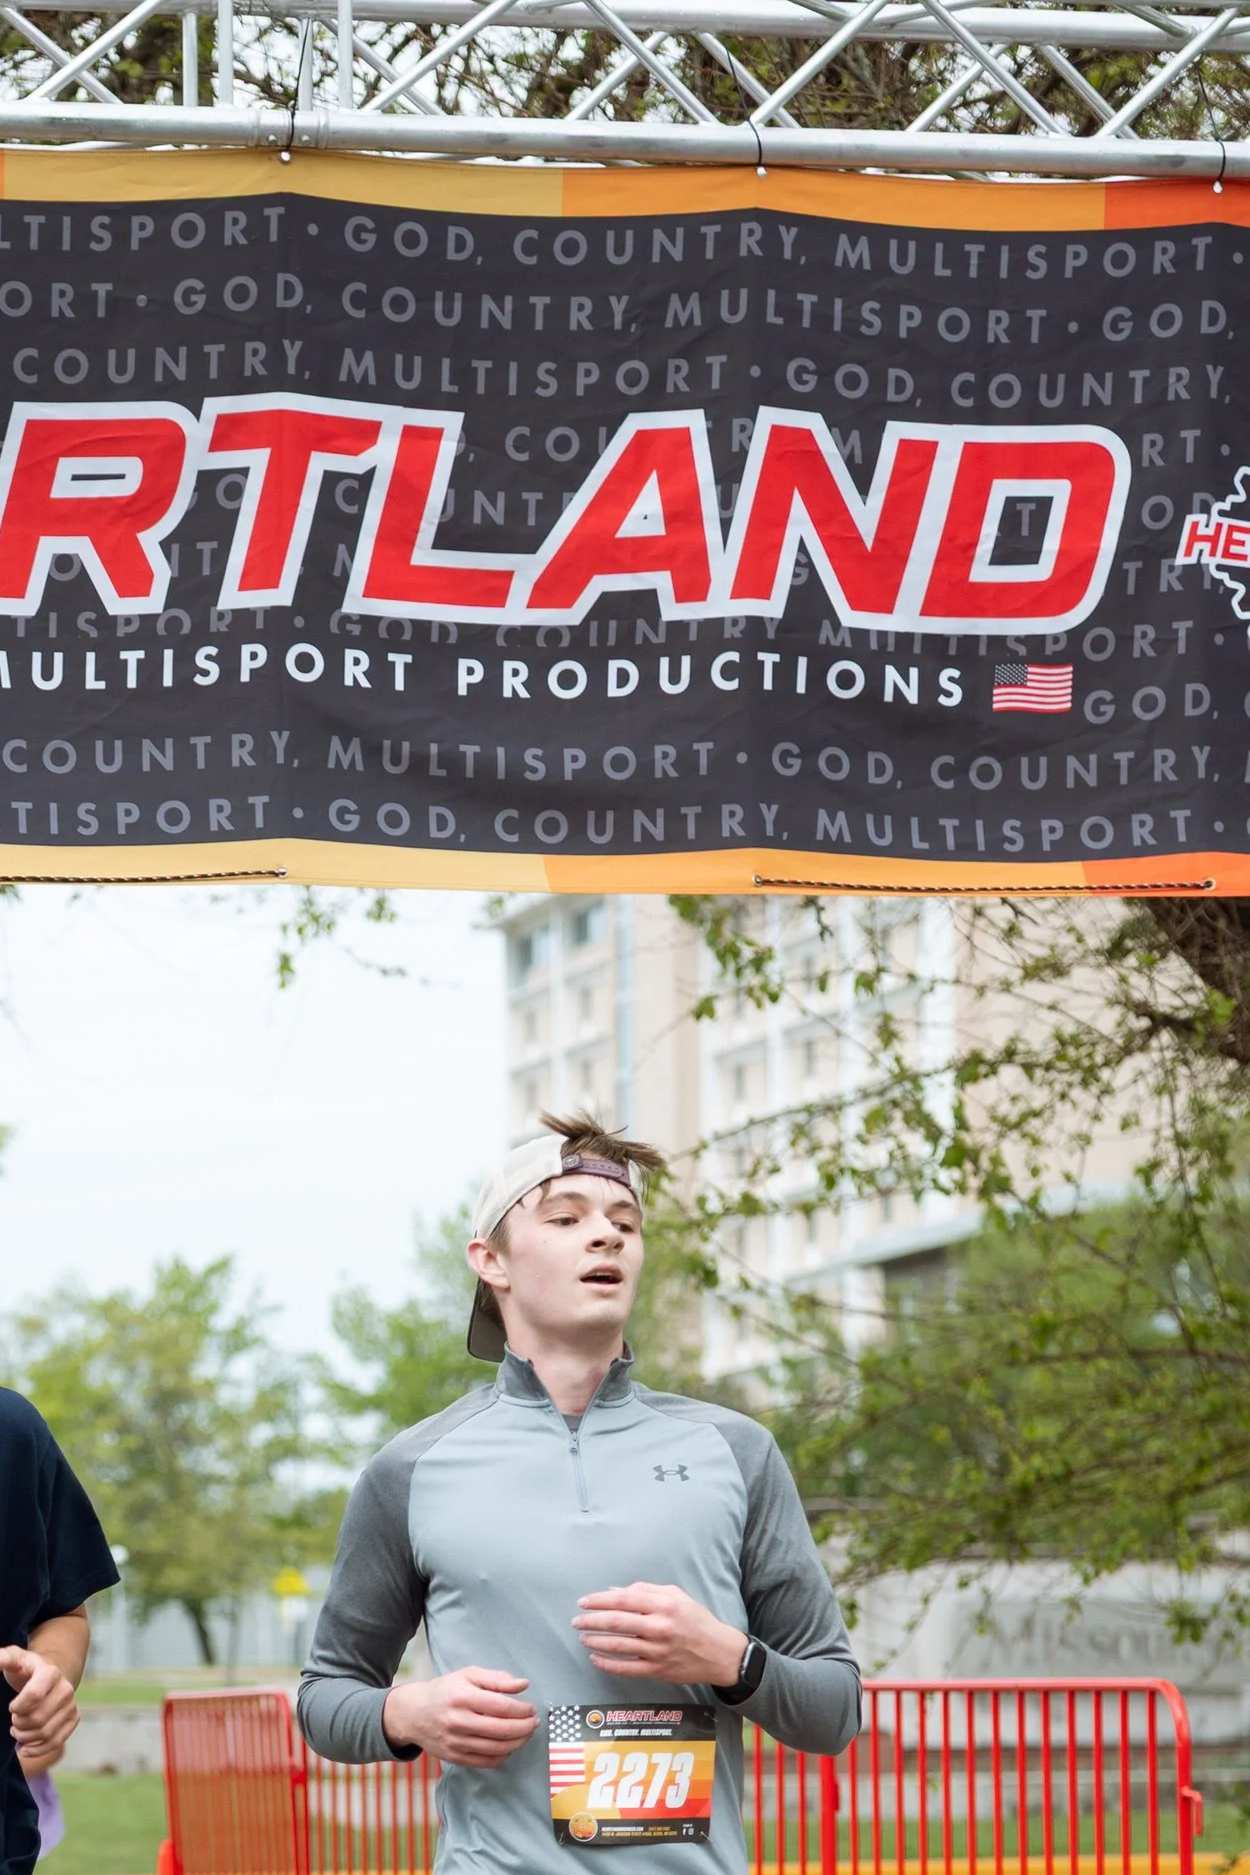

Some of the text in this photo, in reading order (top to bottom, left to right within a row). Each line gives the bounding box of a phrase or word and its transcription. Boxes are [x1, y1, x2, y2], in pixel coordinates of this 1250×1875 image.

[344, 216, 483, 266] GOD,
[513, 221, 806, 267] COUNTRY,
[834, 233, 1212, 279] MULTISPORT
[174, 273, 312, 314] GOD,
[342, 282, 636, 332] COUNTRY,
[665, 288, 1047, 343] MULTISPORT
[1103, 300, 1235, 342] GOD,
[13, 339, 311, 384] COUNTRY,
[339, 348, 727, 397] MULTISPORT
[786, 358, 921, 407] GOD,
[951, 364, 1230, 408] COUNTRY,
[457, 650, 963, 707] PRODUCTIONS
[1083, 682, 1218, 723] GOD,
[2, 731, 299, 774] COUNTRY,
[327, 736, 714, 780] MULTISPORT
[772, 742, 902, 789] GOD,
[930, 746, 1219, 791] COUNTRY,
[329, 799, 467, 843] GOD,
[494, 803, 788, 845] COUNTRY,
[816, 808, 1191, 852] MULTISPORT
[606, 1710, 682, 1722] HEARTLAND
[586, 1752, 694, 1809] 2273
